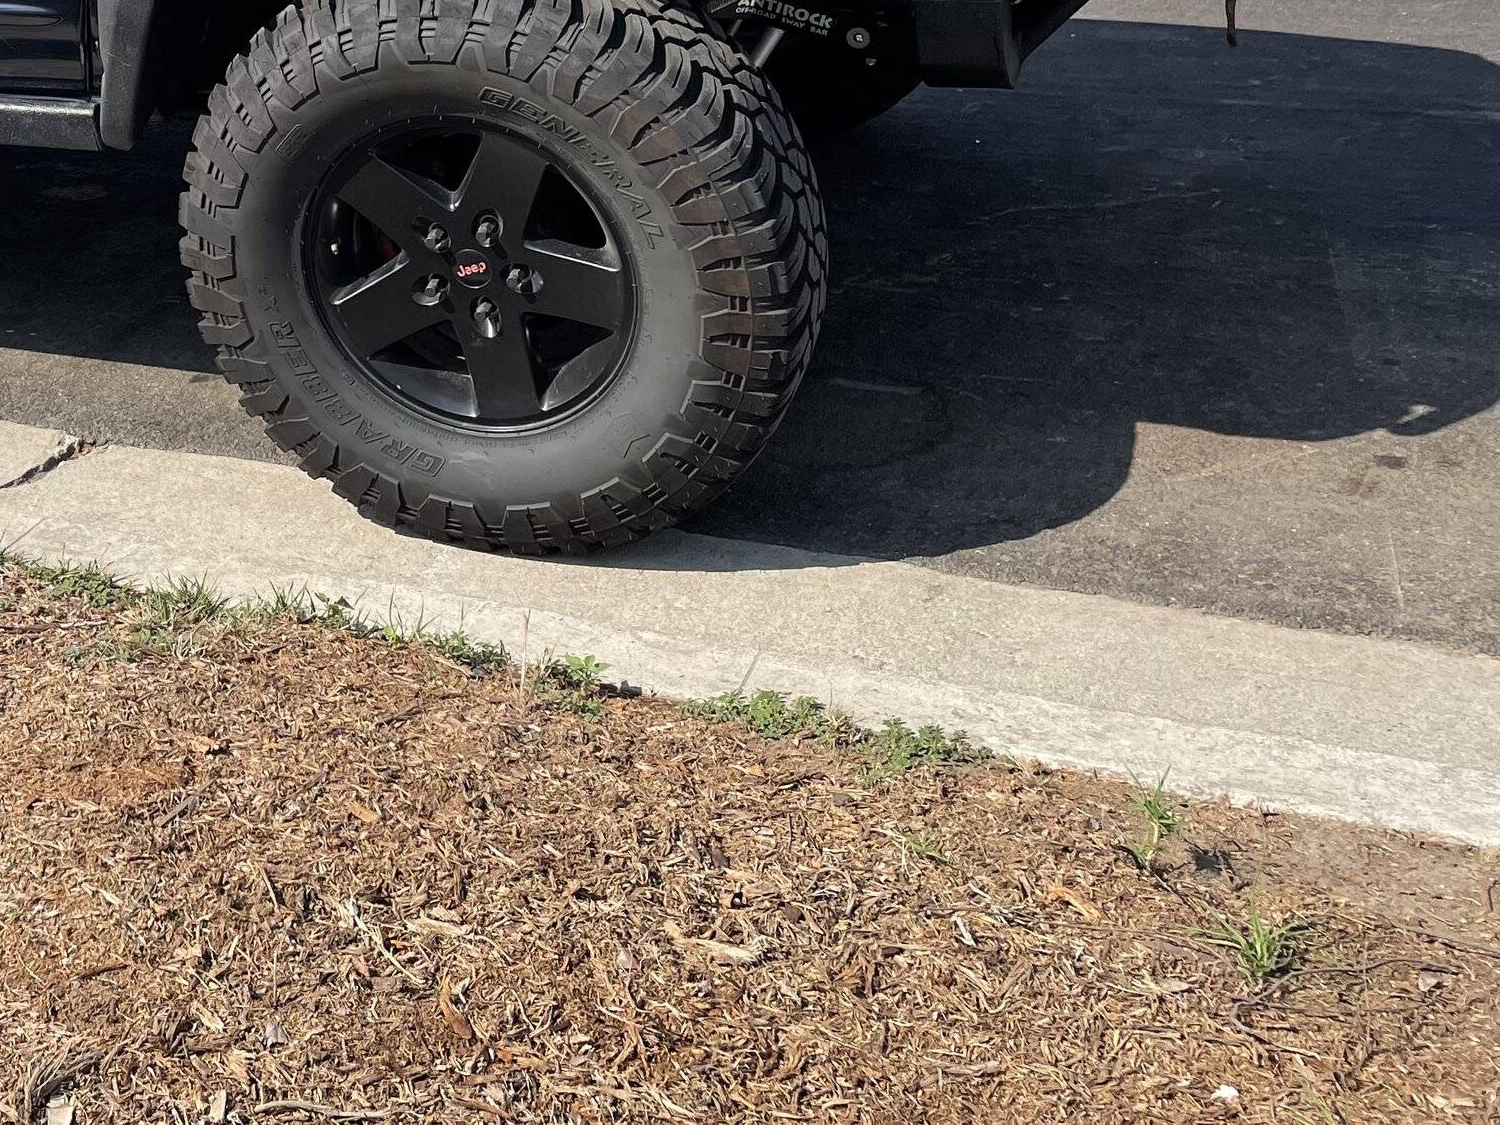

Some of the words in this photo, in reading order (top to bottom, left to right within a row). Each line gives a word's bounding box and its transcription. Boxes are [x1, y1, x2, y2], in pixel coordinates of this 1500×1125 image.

[735, 6, 777, 20] OFF-ROAD
[781, 17, 806, 28] SWAY
[810, 26, 829, 36] BAR
[477, 85, 666, 251] GENERAL
[457, 261, 487, 277] Jeep
[268, 320, 447, 478] GRABBER
